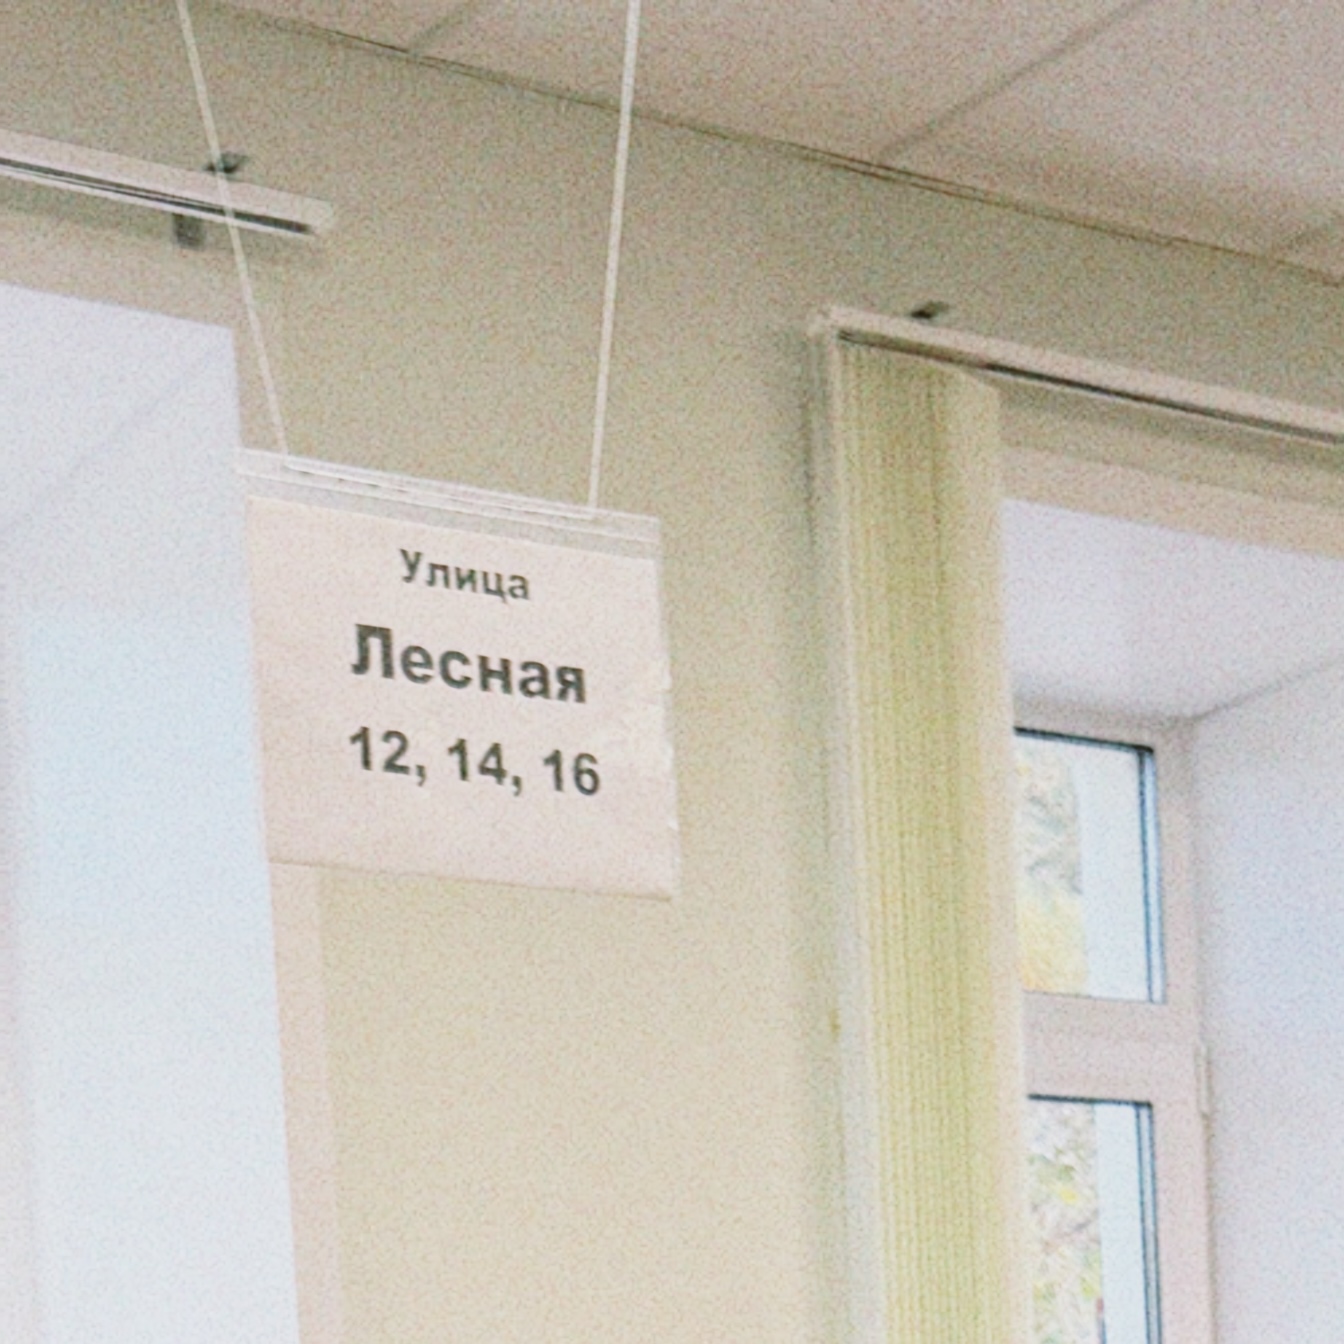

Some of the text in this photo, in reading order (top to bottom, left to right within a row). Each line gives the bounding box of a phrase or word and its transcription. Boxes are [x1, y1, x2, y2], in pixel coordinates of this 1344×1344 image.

[399, 548, 530, 604] Улица
[350, 622, 588, 704] Лесная
[349, 725, 601, 797] 12, 14, 16
